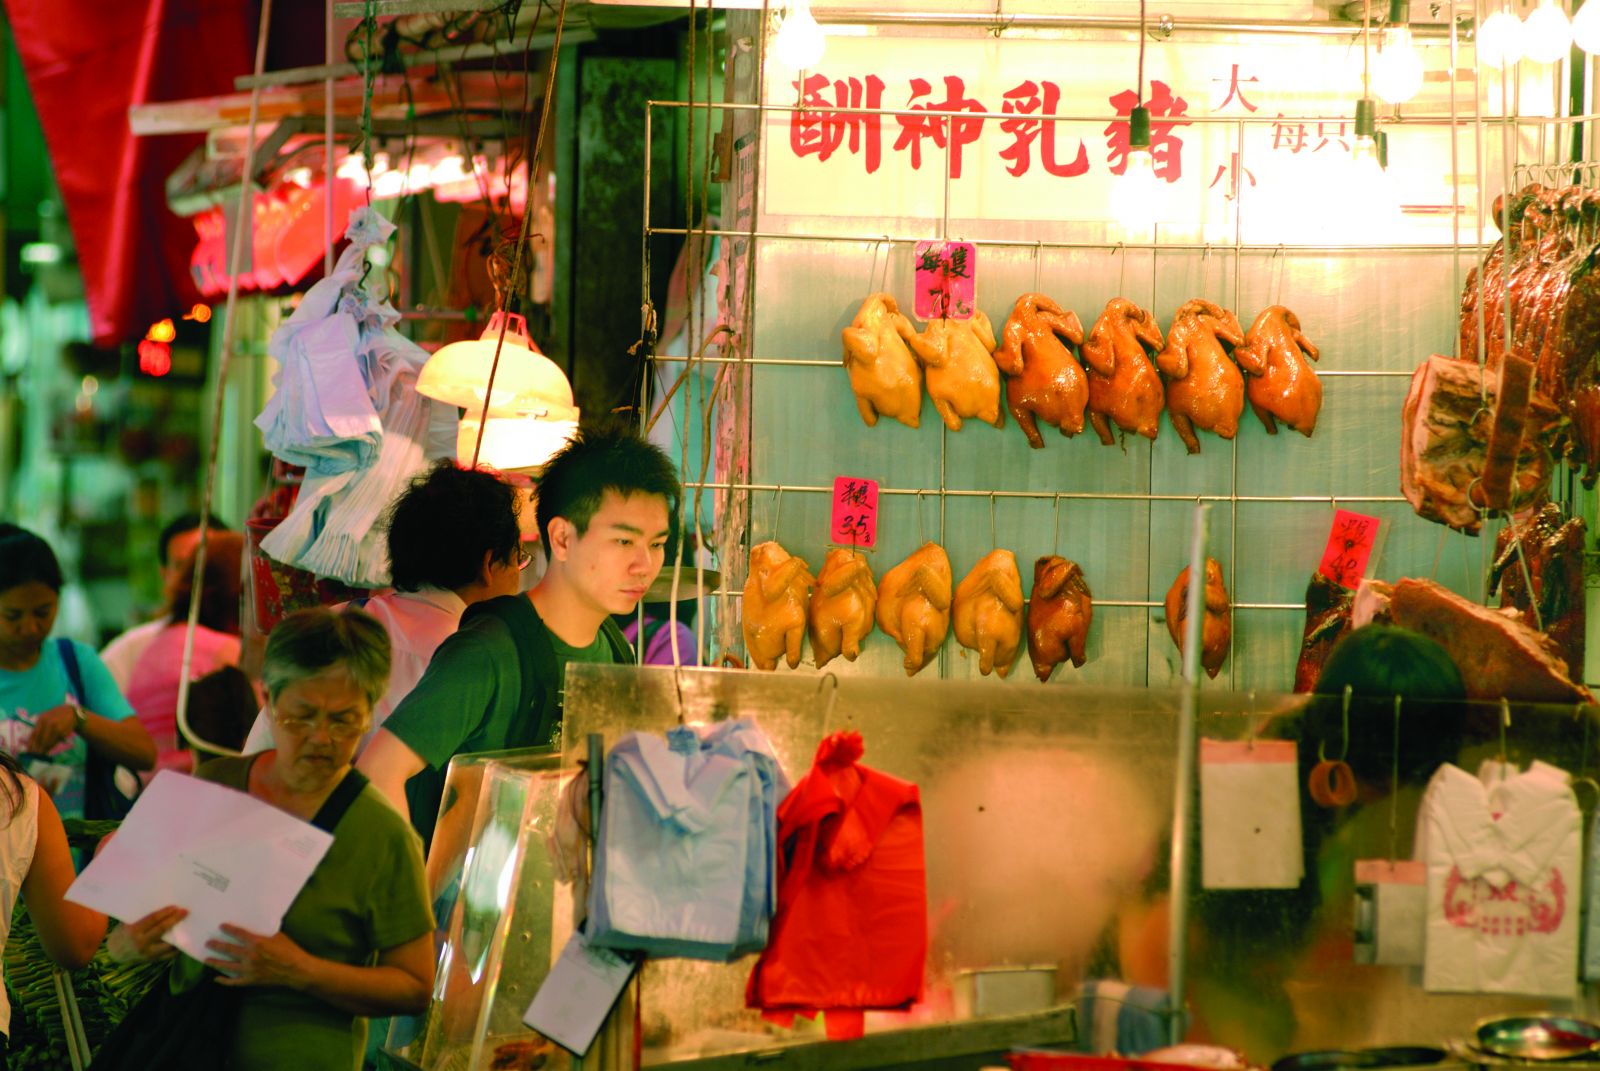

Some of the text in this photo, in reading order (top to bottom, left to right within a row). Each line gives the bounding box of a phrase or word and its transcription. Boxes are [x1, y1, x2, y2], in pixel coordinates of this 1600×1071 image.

[1211, 64, 1259, 113] 大
[790, 74, 1193, 183] 酬神乳豬
[1209, 152, 1256, 200] 小
